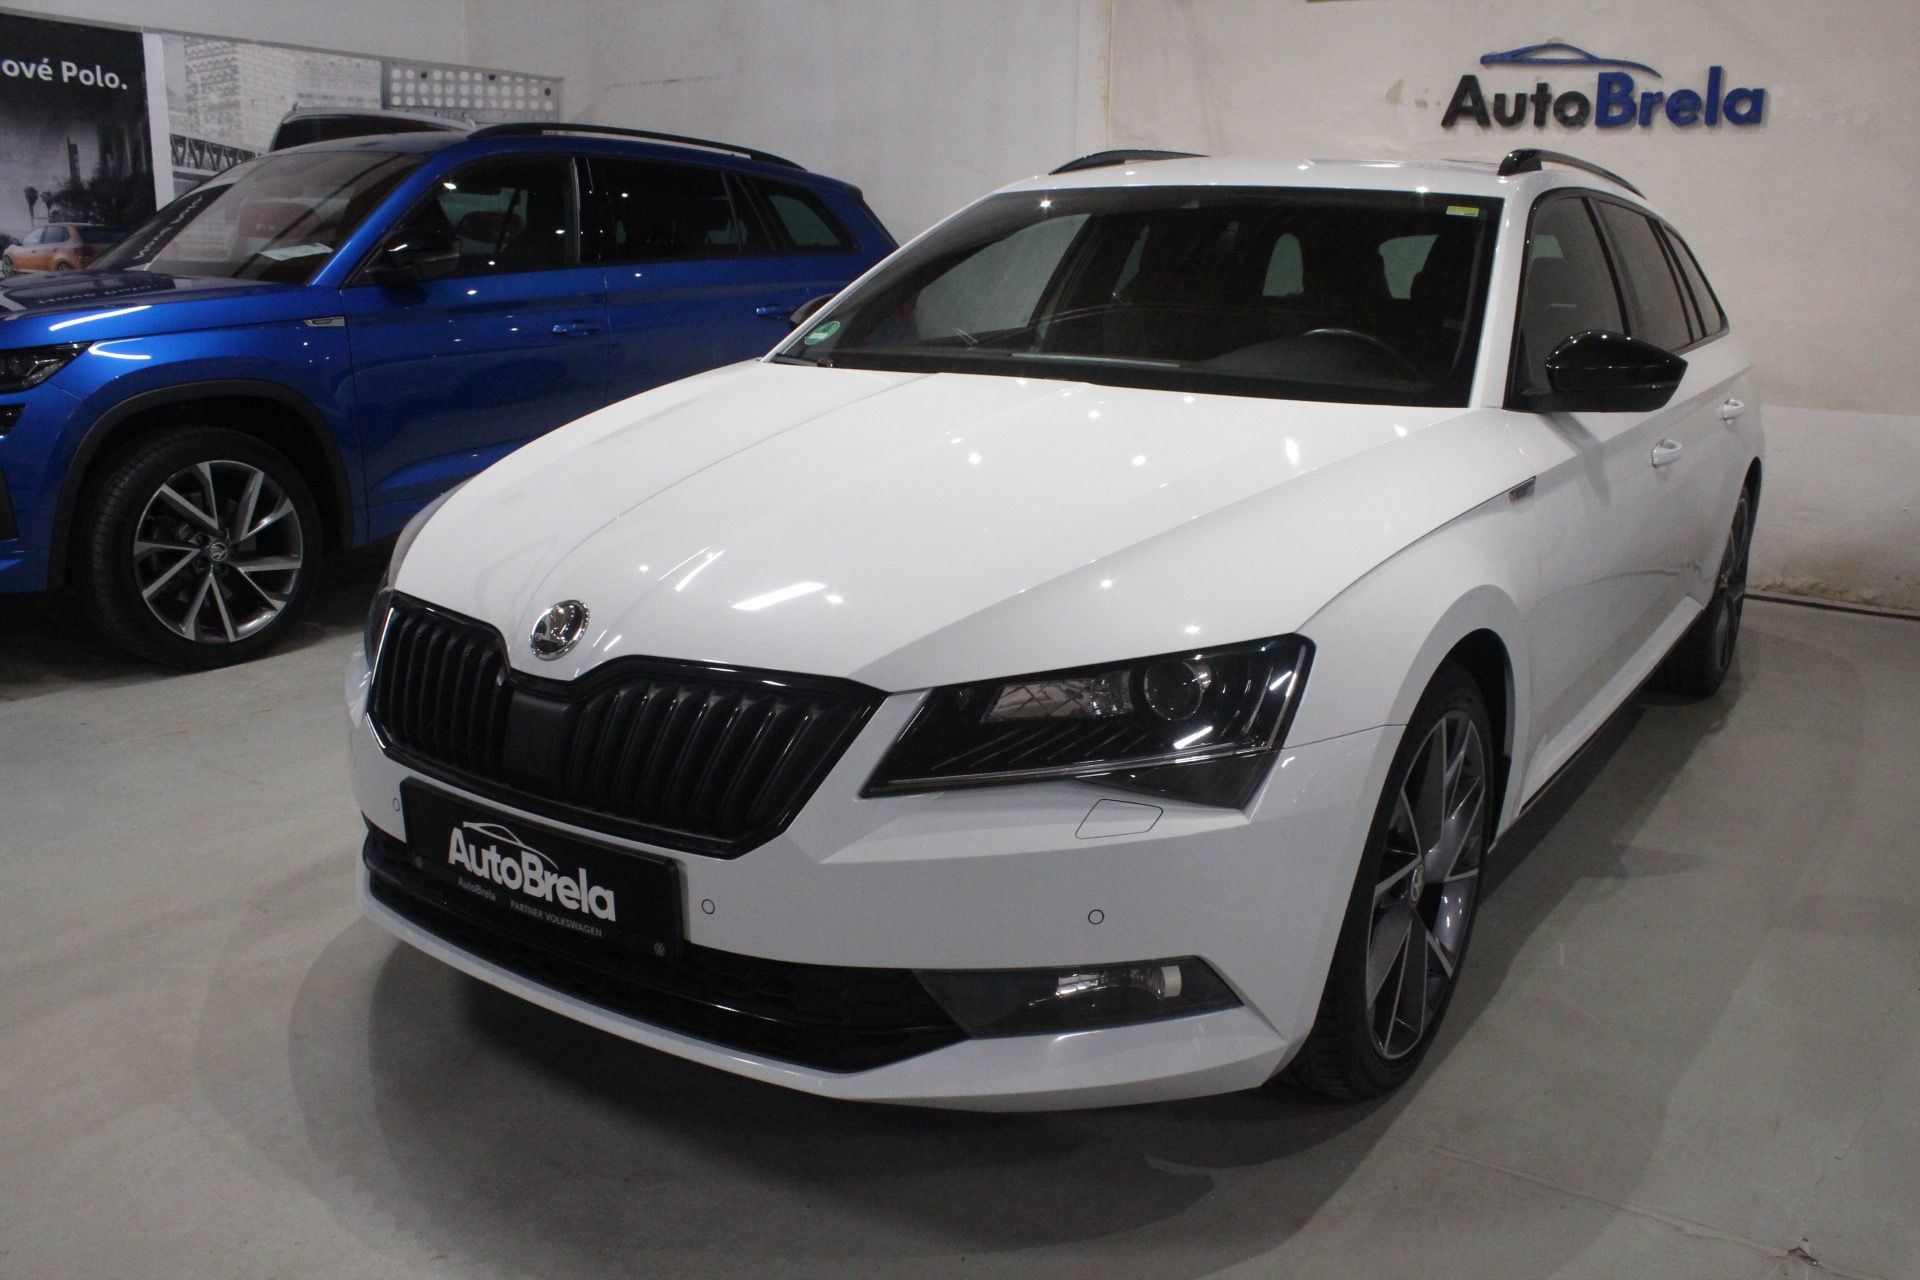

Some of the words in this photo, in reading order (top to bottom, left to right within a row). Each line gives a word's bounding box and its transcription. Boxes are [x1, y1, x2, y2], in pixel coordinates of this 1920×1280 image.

[61, 60, 128, 90] Polo.
[1441, 65, 1765, 128] AutoBrela
[448, 826, 616, 922] AutoBrela
[510, 900, 544, 920] PARTNER
[545, 911, 602, 937] VOLKSWAGEN
